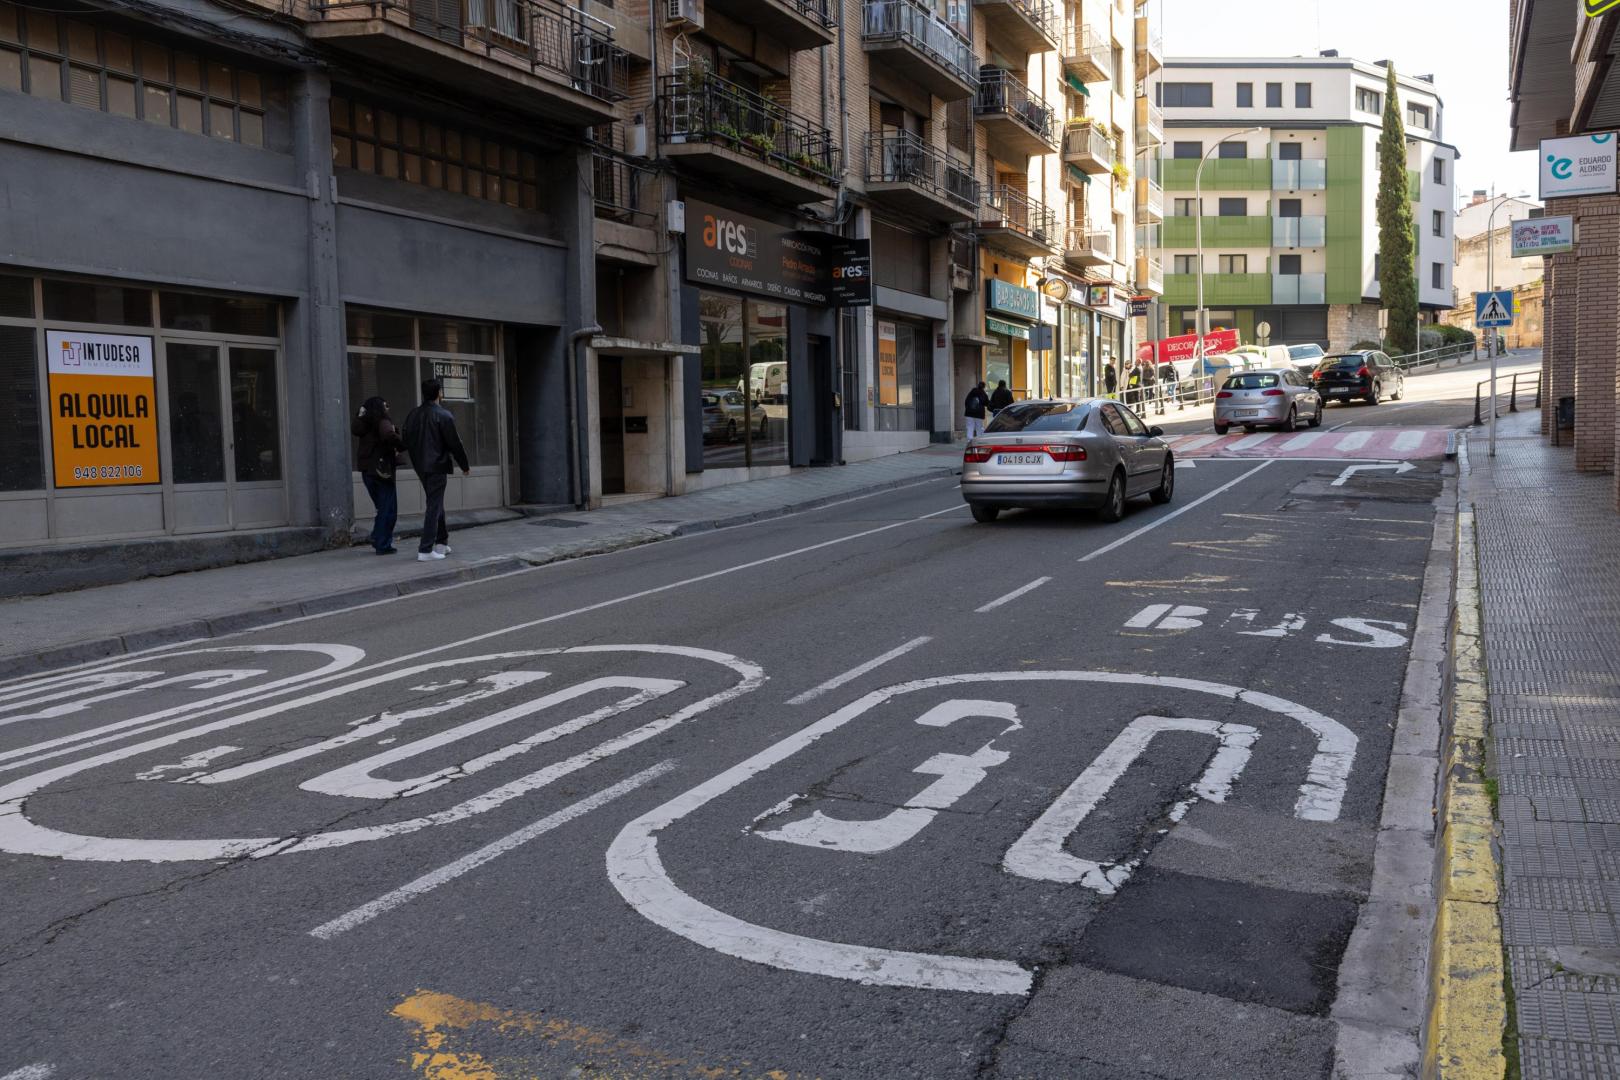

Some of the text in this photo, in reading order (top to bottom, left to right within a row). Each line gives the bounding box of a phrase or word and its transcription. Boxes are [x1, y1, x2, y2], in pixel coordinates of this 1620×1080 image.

[1579, 155, 1612, 165] EDUARDO
[1579, 164, 1607, 173] ALONSO
[703, 214, 747, 255] ares
[831, 265, 863, 279] ares
[696, 267, 719, 281] COCINAS
[722, 273, 738, 285] BAÑOS
[784, 286, 801, 297] CALIDAD
[83, 342, 139, 363] INTUDESA
[436, 363, 467, 377] SE ALQUILA
[59, 393, 148, 420] ALQUILA
[72, 424, 140, 449] LOCAL
[1002, 455, 1042, 464] 0419 CJX
[74, 464, 143, 479] 948 822 106
[740, 698, 1263, 895] 30
